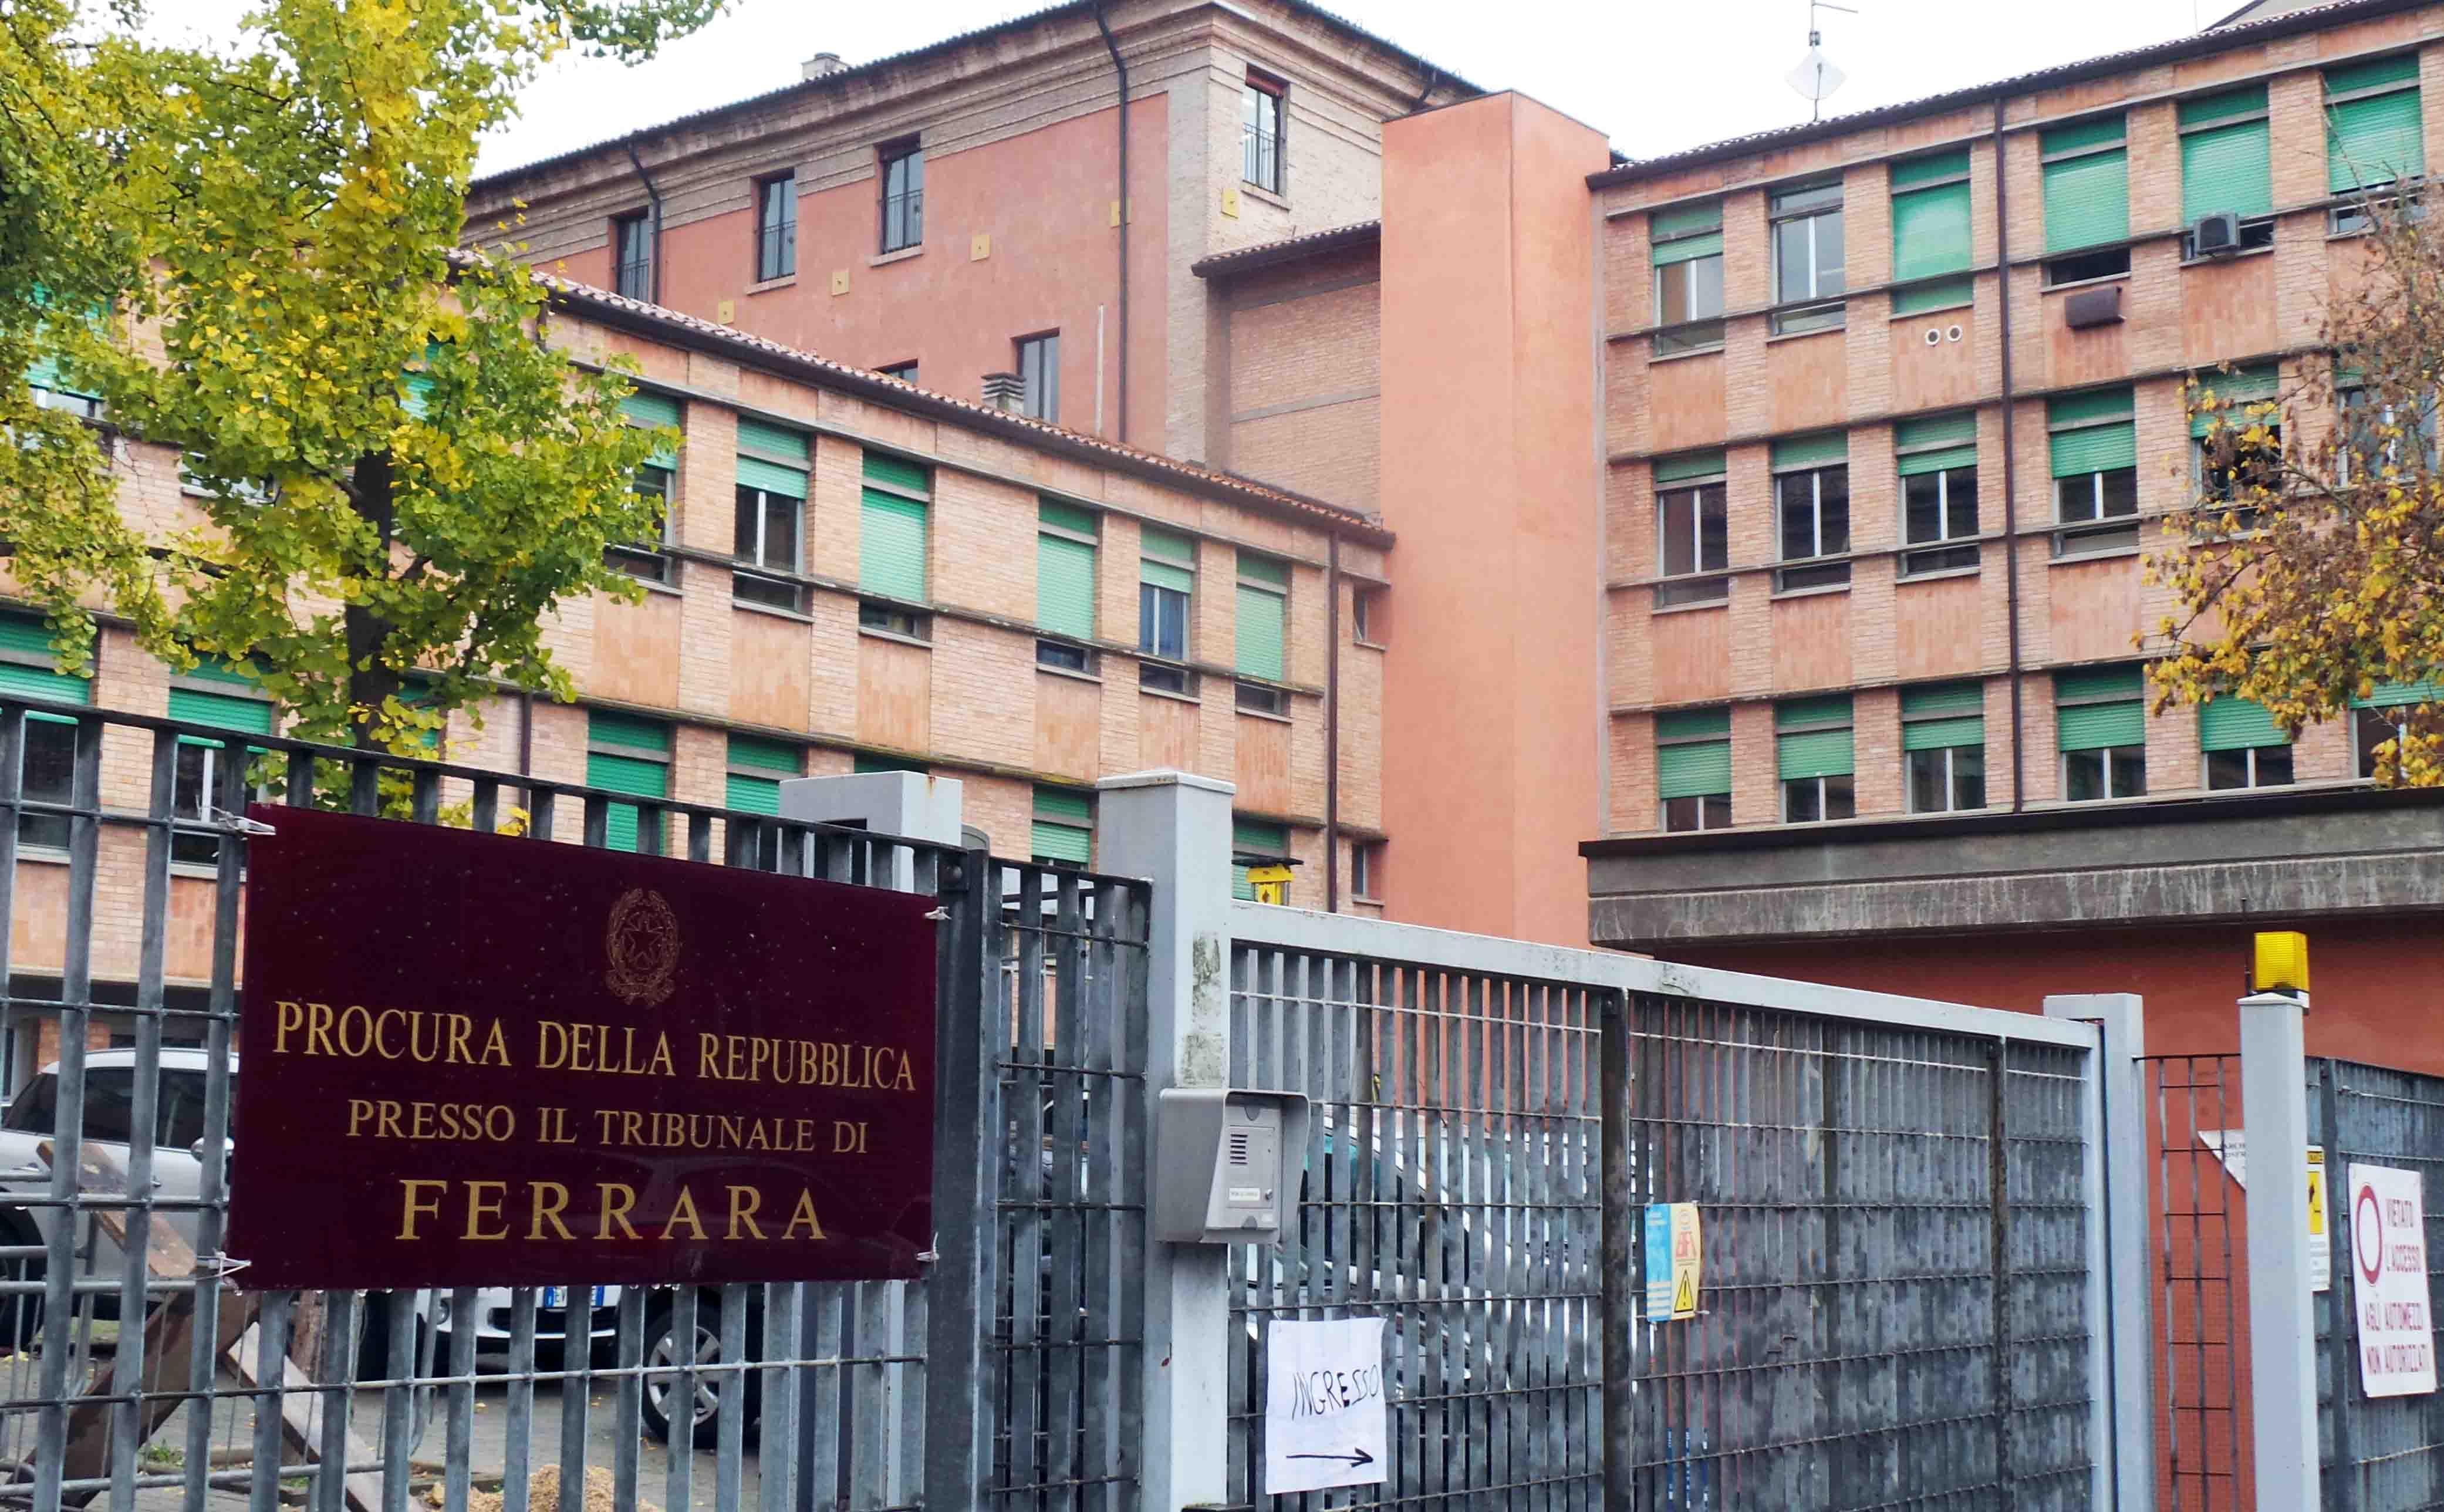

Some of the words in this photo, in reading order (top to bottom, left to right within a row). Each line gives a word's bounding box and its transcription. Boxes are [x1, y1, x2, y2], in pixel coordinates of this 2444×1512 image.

[273, 1000, 512, 1066] PROCURA
[536, 1020, 675, 1075] DELLA
[700, 1032, 916, 1091] REPUBBLICA
[347, 1099, 515, 1142] PRESSO
[538, 1107, 576, 1144] IL
[595, 1110, 815, 1152] TRIBUNALE
[833, 1120, 867, 1153] DI
[395, 1180, 826, 1240] FERRARA
[1292, 1364, 1380, 1420] INGRESSO
